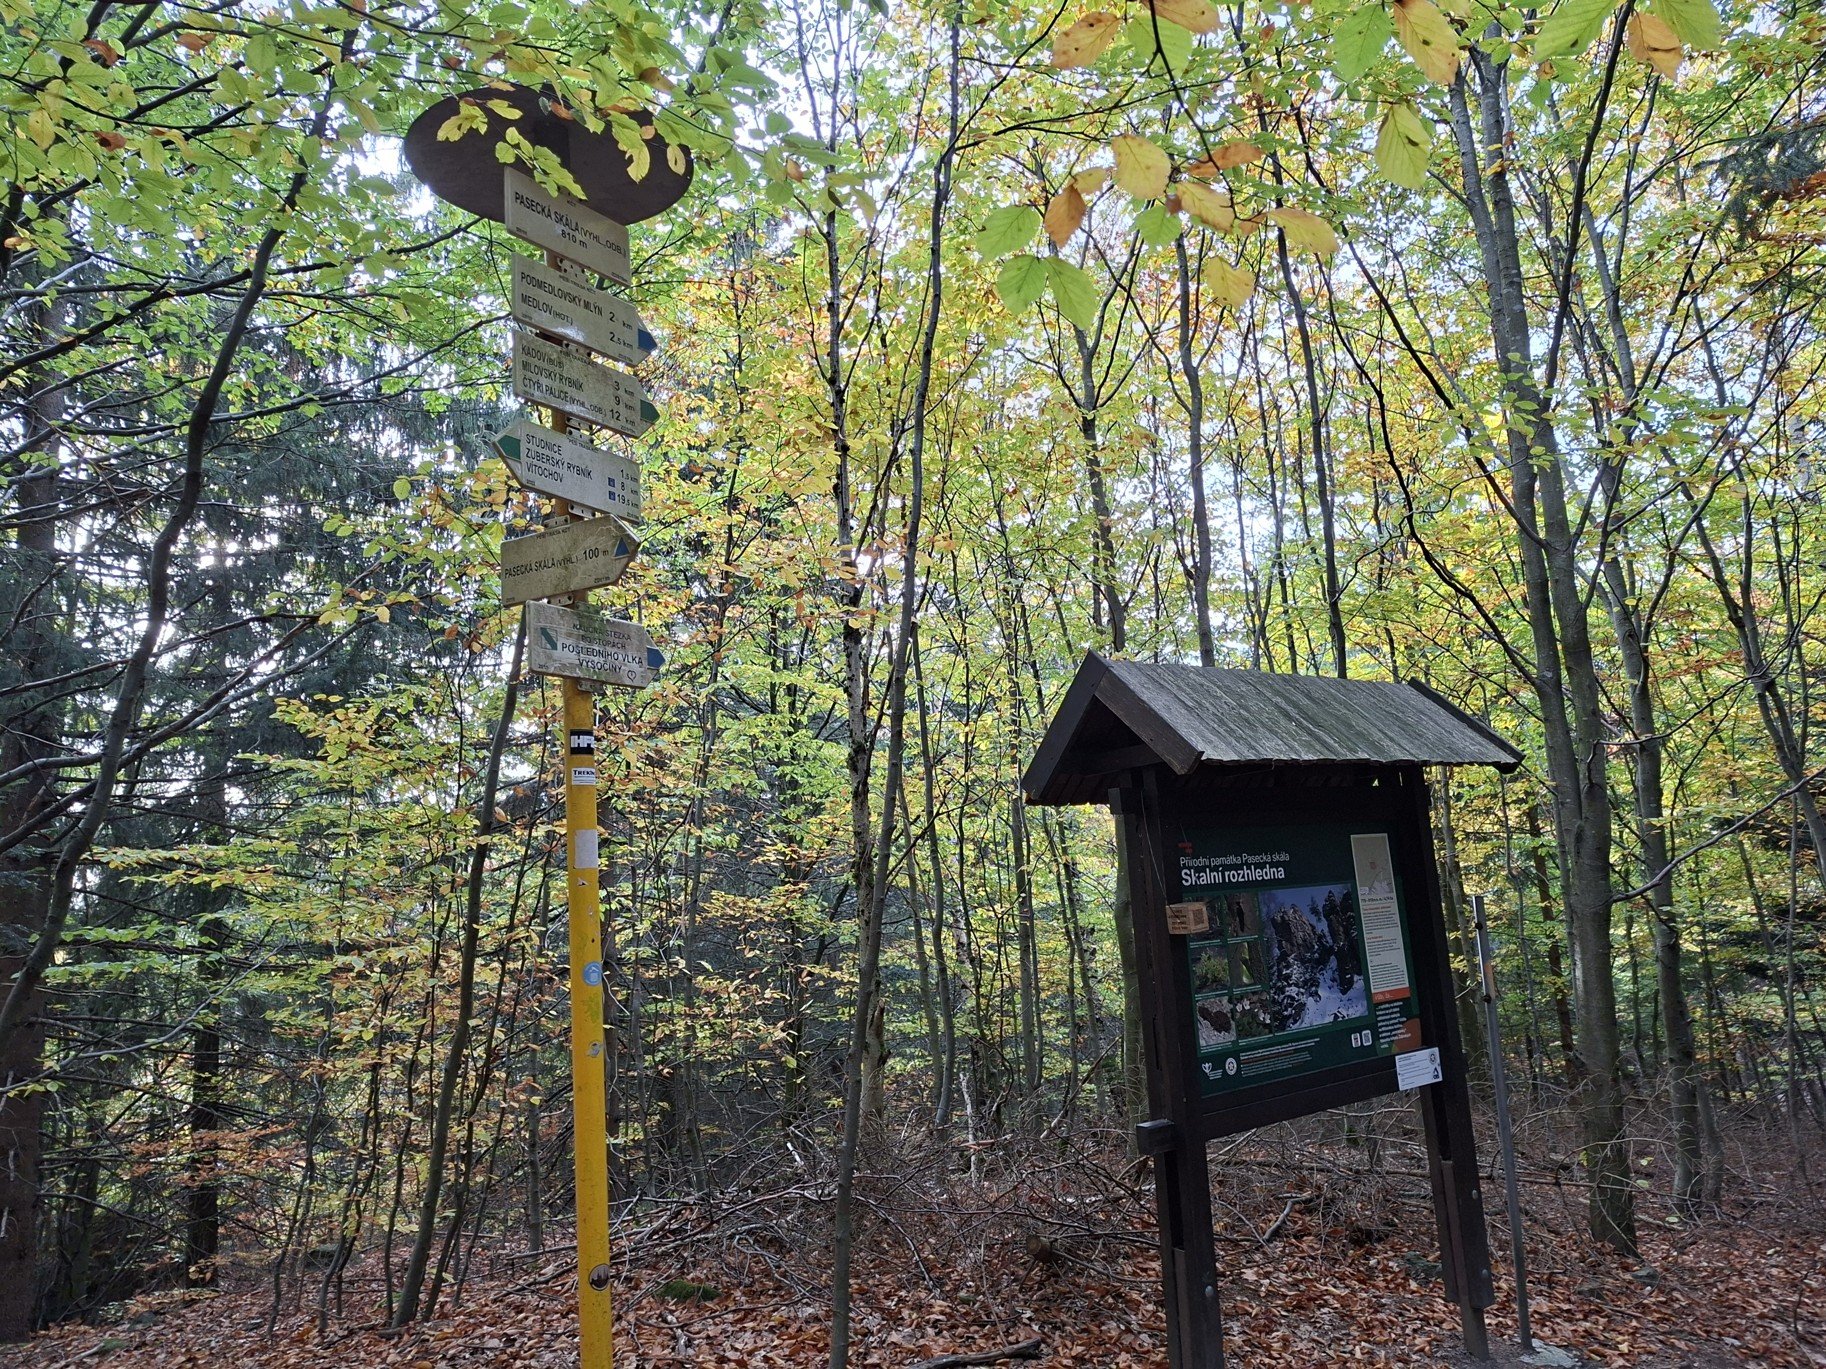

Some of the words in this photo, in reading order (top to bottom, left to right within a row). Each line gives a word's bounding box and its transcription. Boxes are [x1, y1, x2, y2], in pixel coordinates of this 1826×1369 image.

[515, 191, 553, 222] PASECKÁ
[554, 211, 580, 234] SKÁLA
[561, 229, 577, 244] 810
[579, 239, 588, 249] m
[521, 271, 582, 308] PODMEDLOVSKÝ
[583, 299, 603, 317] MLÝN
[609, 311, 616, 323] 2
[622, 320, 633, 330] km
[521, 293, 553, 316] MEDLOV
[622, 339, 633, 348] km
[521, 344, 547, 364] KADOV
[546, 357, 565, 370] (BUS)
[614, 380, 620, 391] 3
[624, 387, 635, 397] km
[522, 360, 558, 382] MILOVSKÝ
[558, 374, 584, 392] RYBNÍK
[614, 395, 621, 406] 9
[624, 402, 635, 412] km
[522, 374, 544, 394] ČTYŘI
[544, 384, 569, 402] PALICE
[609, 408, 621, 422] 12
[625, 417, 636, 427] km
[525, 433, 562, 456] STUDNICE
[630, 473, 639, 482] km
[525, 447, 565, 470] ZUBERSKÝ
[566, 461, 593, 480] RYBNÍK
[620, 482, 626, 491] 8
[630, 487, 639, 496] km
[525, 460, 564, 483] VÍTOCHOV
[631, 501, 639, 510] km
[504, 560, 534, 579] PASECKÁ
[534, 557, 558, 572] SKÁLA
[582, 547, 600, 561] 100
[561, 642, 619, 661] POSLEDNÍHO
[621, 654, 644, 666] VLKA
[581, 634, 591, 643] PO
[594, 637, 626, 650] STOPÁCH
[605, 629, 632, 641] STEZKA
[578, 657, 622, 674] VYSOČINY
[1180, 855, 1210, 867] Přírodní
[1210, 854, 1242, 868] památka
[1242, 852, 1272, 864] Pasecká
[1272, 851, 1290, 862] skála
[1181, 866, 1223, 886] Skalní
[1224, 864, 1286, 883] rozhledna
